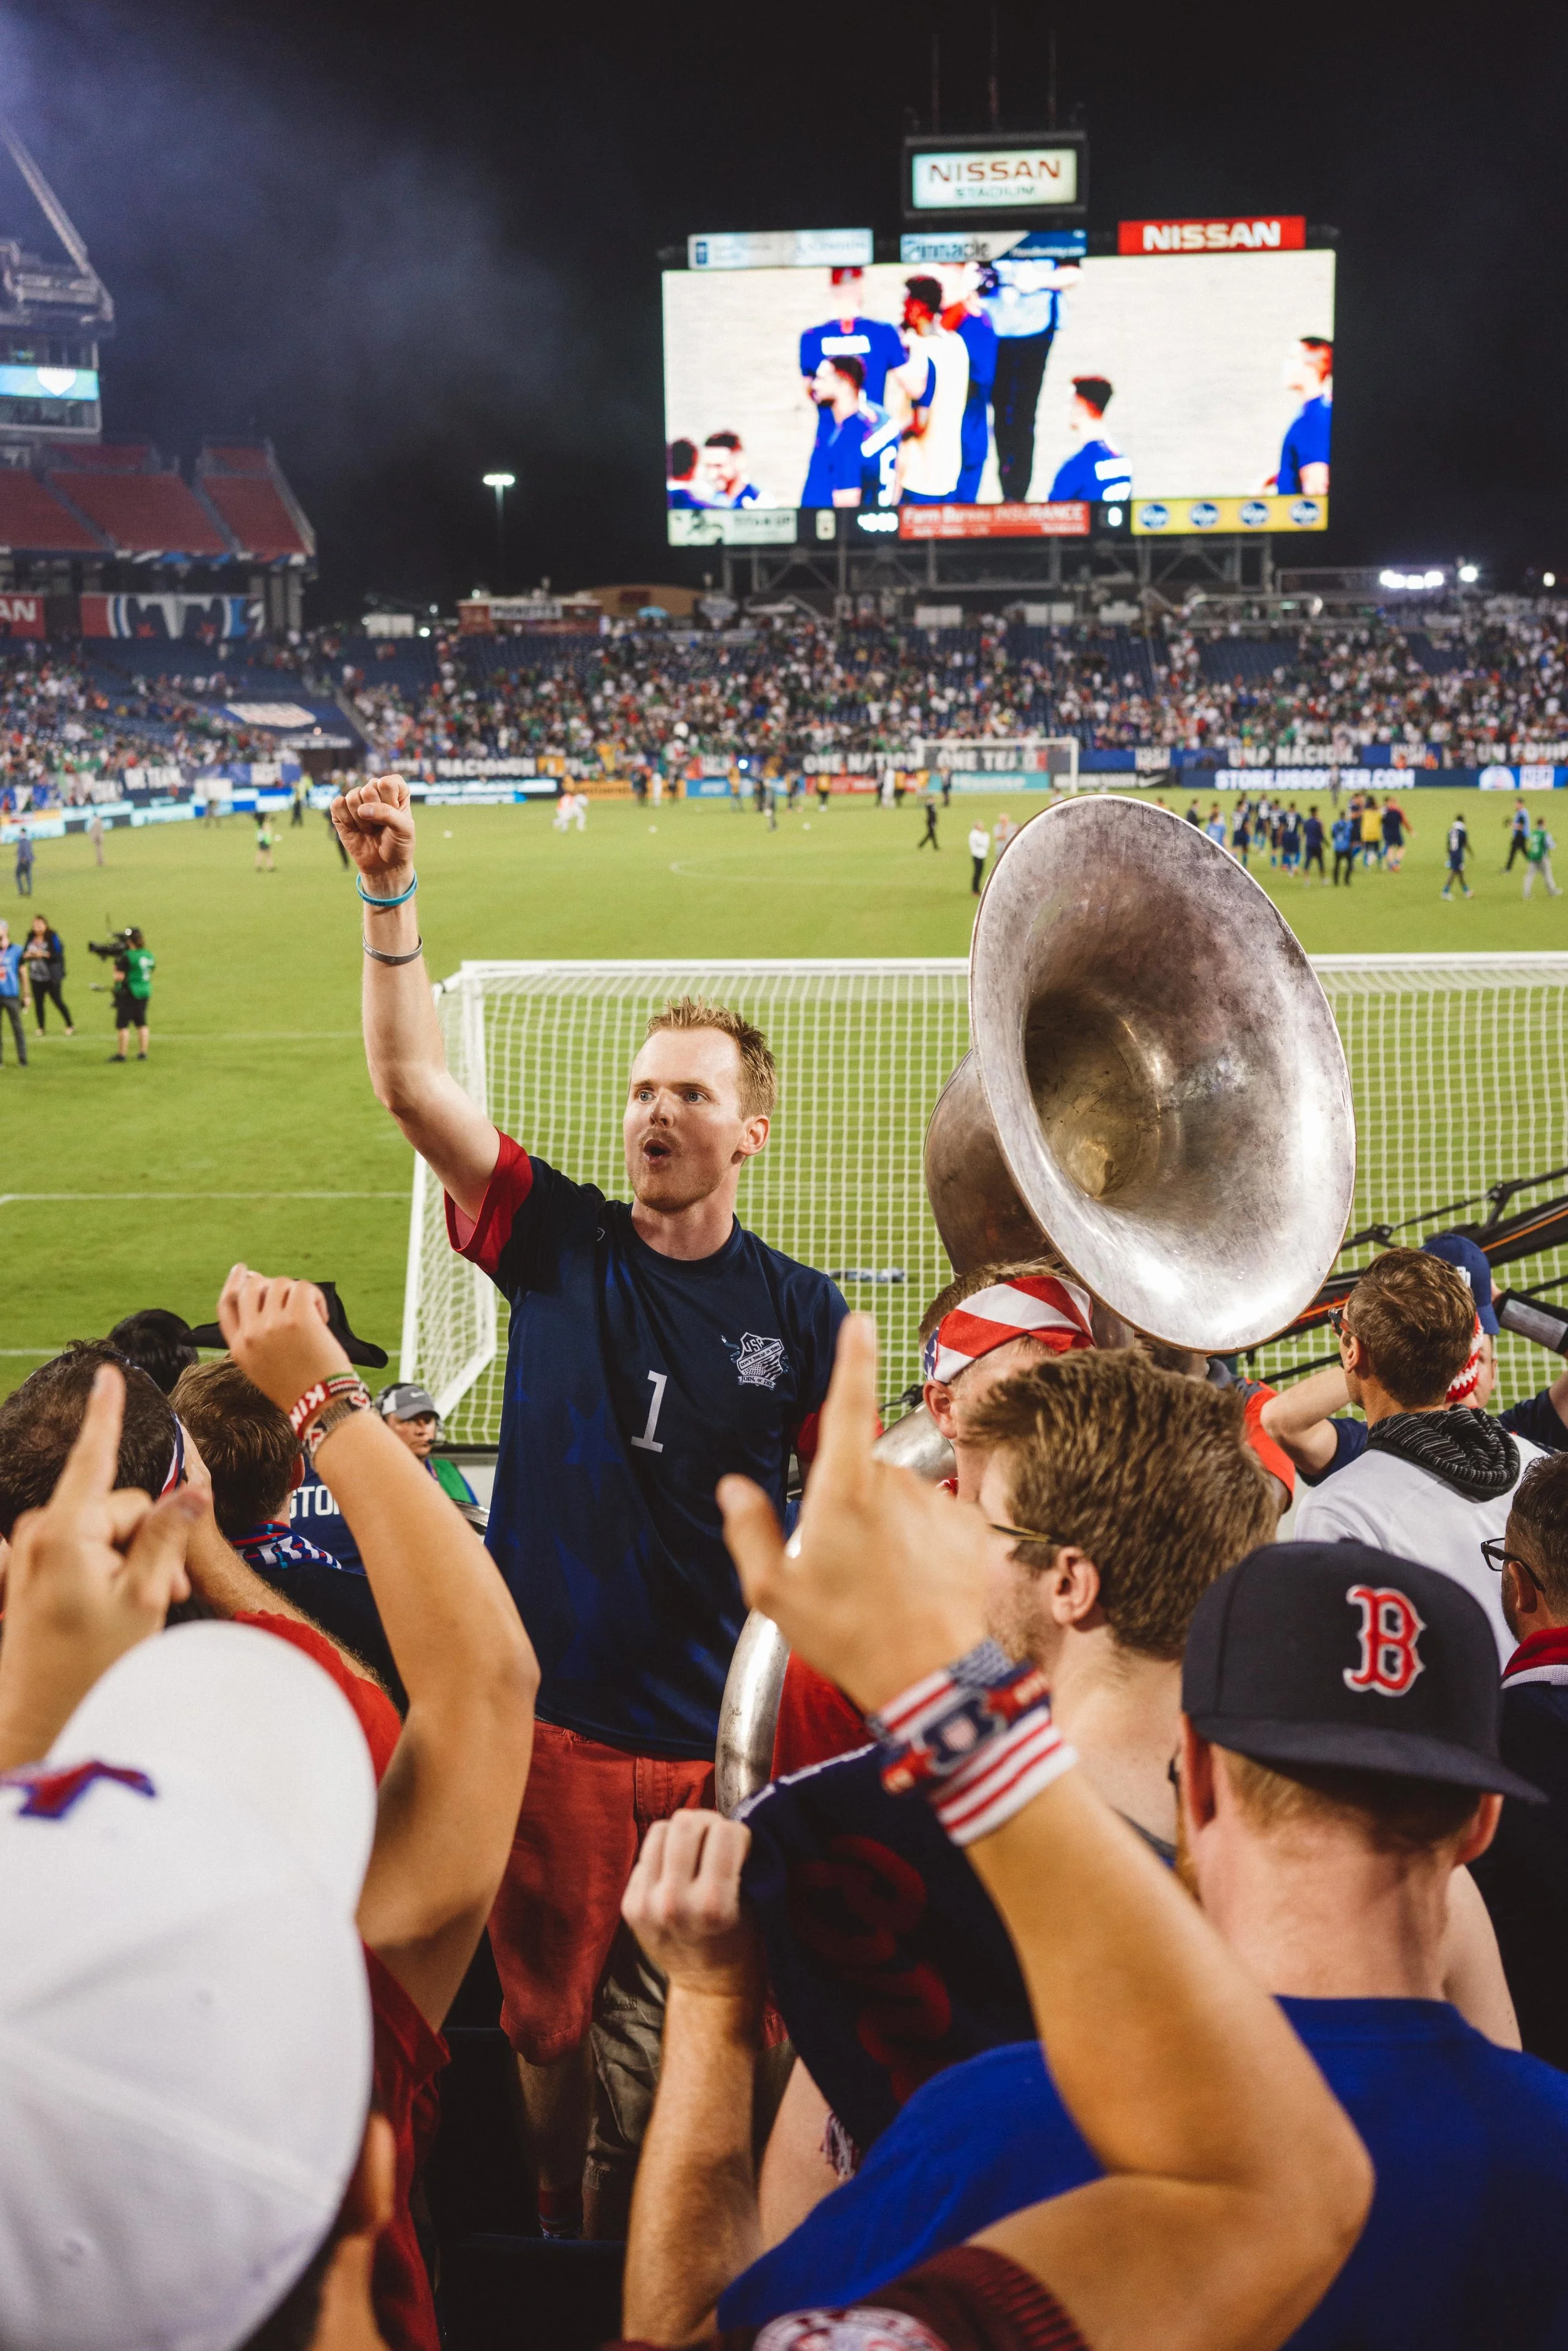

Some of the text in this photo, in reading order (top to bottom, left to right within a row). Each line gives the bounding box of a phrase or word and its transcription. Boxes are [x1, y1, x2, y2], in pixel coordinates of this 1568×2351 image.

[930, 159, 1061, 183] NISSAN
[1142, 221, 1281, 250] NISSAN
[994, 502, 1084, 521] INSURANCE
[803, 753, 842, 774] ONE
[937, 751, 978, 772] ONE
[743, 1338, 764, 1352] USA
[740, 1359, 753, 1367] DON'T
[753, 1352, 766, 1361] TREAD
[631, 1370, 667, 1453] 1
[1343, 1584, 1428, 1697] B
